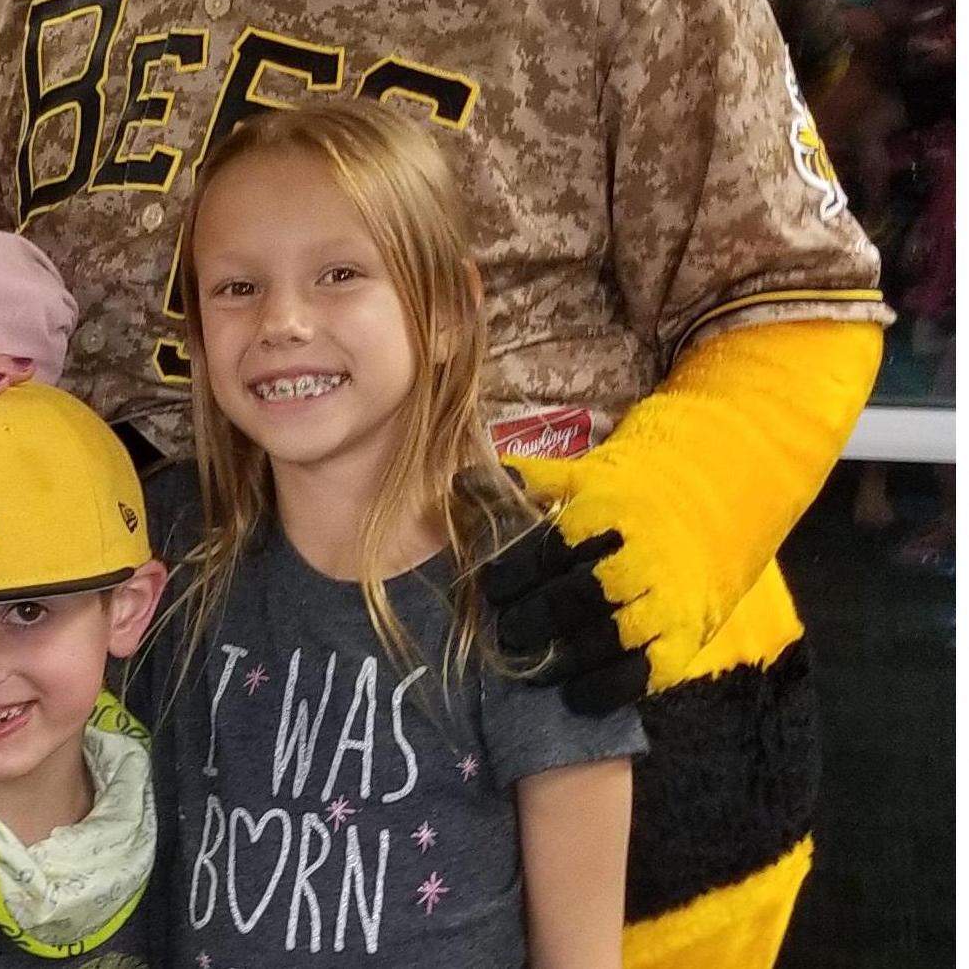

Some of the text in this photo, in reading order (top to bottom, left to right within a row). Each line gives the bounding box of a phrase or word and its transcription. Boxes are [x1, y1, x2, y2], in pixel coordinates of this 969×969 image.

[506, 422, 580, 457] Rawlings
[201, 643, 429, 804] I WAS
